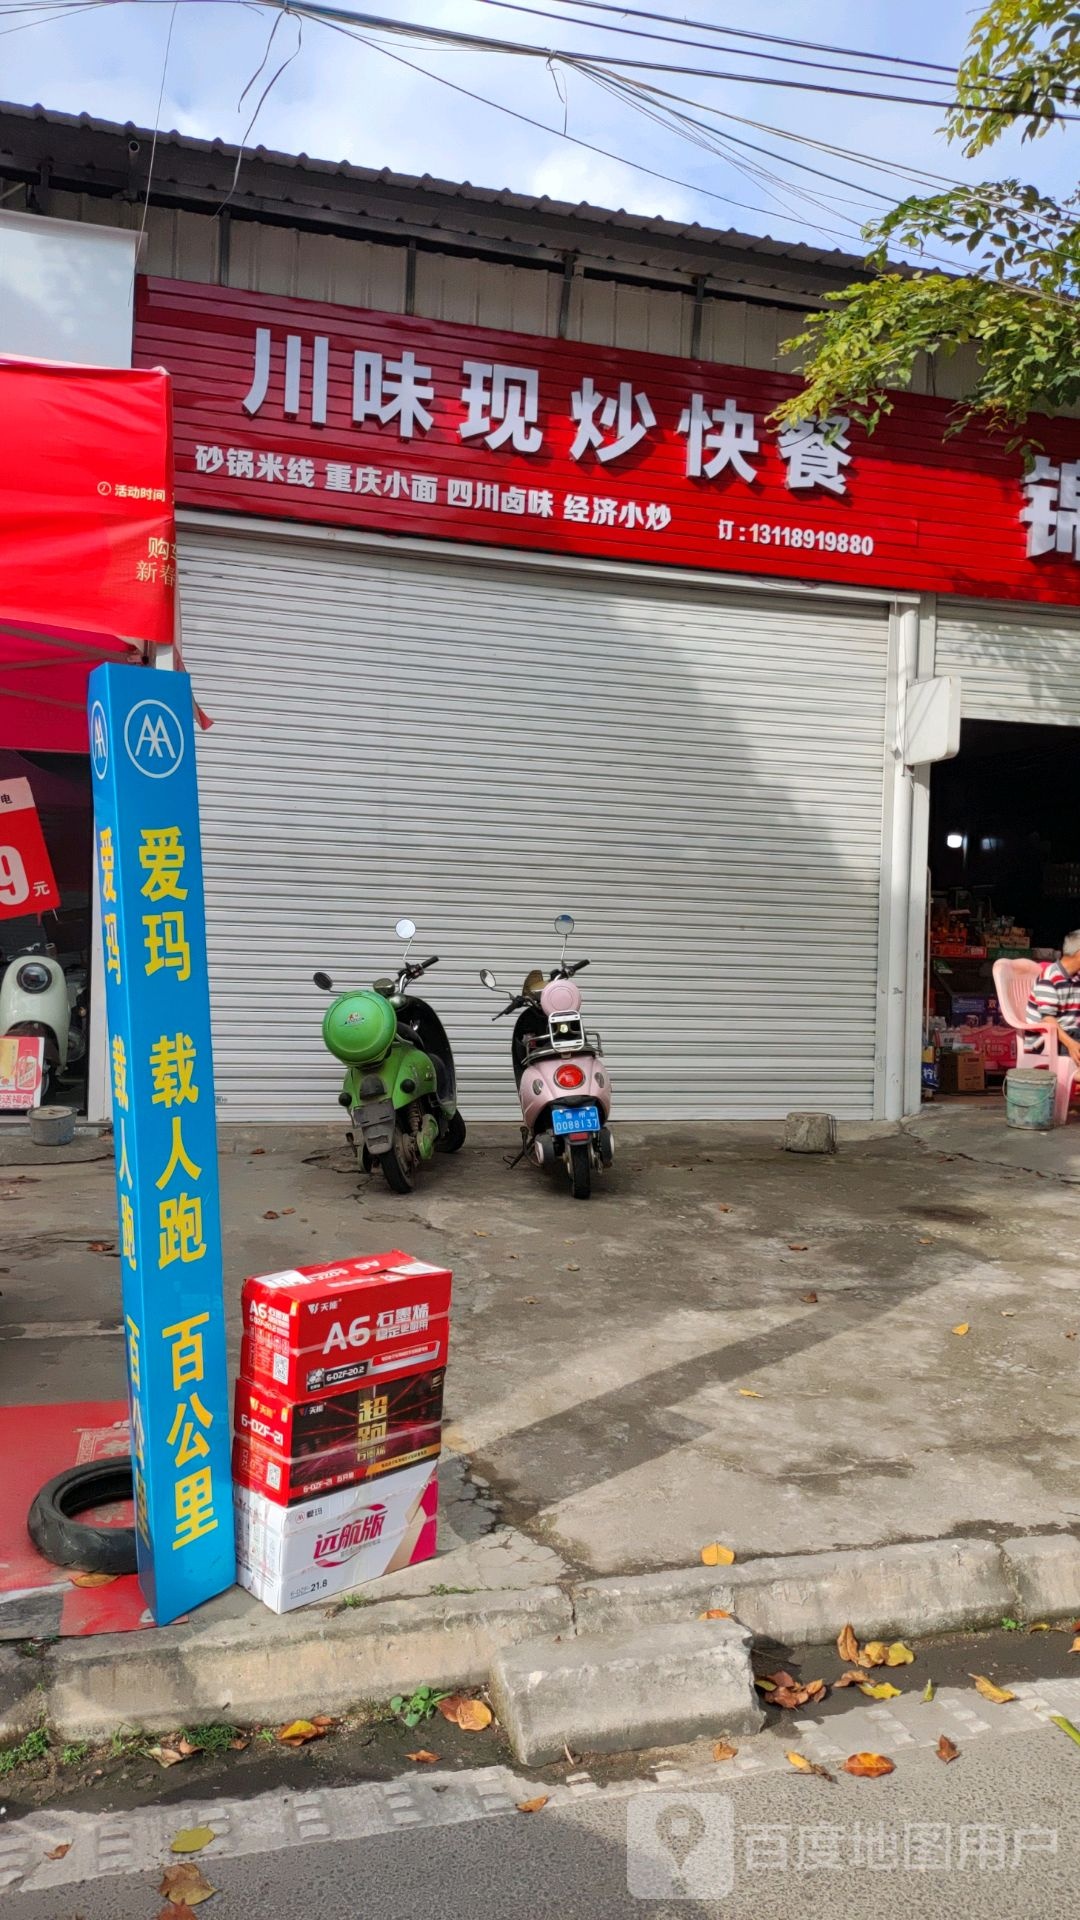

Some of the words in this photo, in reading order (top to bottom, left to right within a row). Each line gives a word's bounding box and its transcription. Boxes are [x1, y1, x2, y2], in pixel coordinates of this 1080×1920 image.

[241, 327, 855, 496] 川味现炒快餐
[195, 444, 316, 488] 砂锅米线
[325, 462, 438, 503] 重庆小面
[447, 478, 554, 518] 四川卤味
[563, 494, 672, 531] 经济小炒
[33, 881, 50, 897] 元
[138, 826, 191, 981] 爱玛
[150, 1032, 207, 1270] 载人跑
[250, 1299, 268, 1319] A6
[322, 1315, 371, 1354] A6
[161, 1312, 219, 1550] 百公里
[313, 1510, 389, 1560] 远航版
